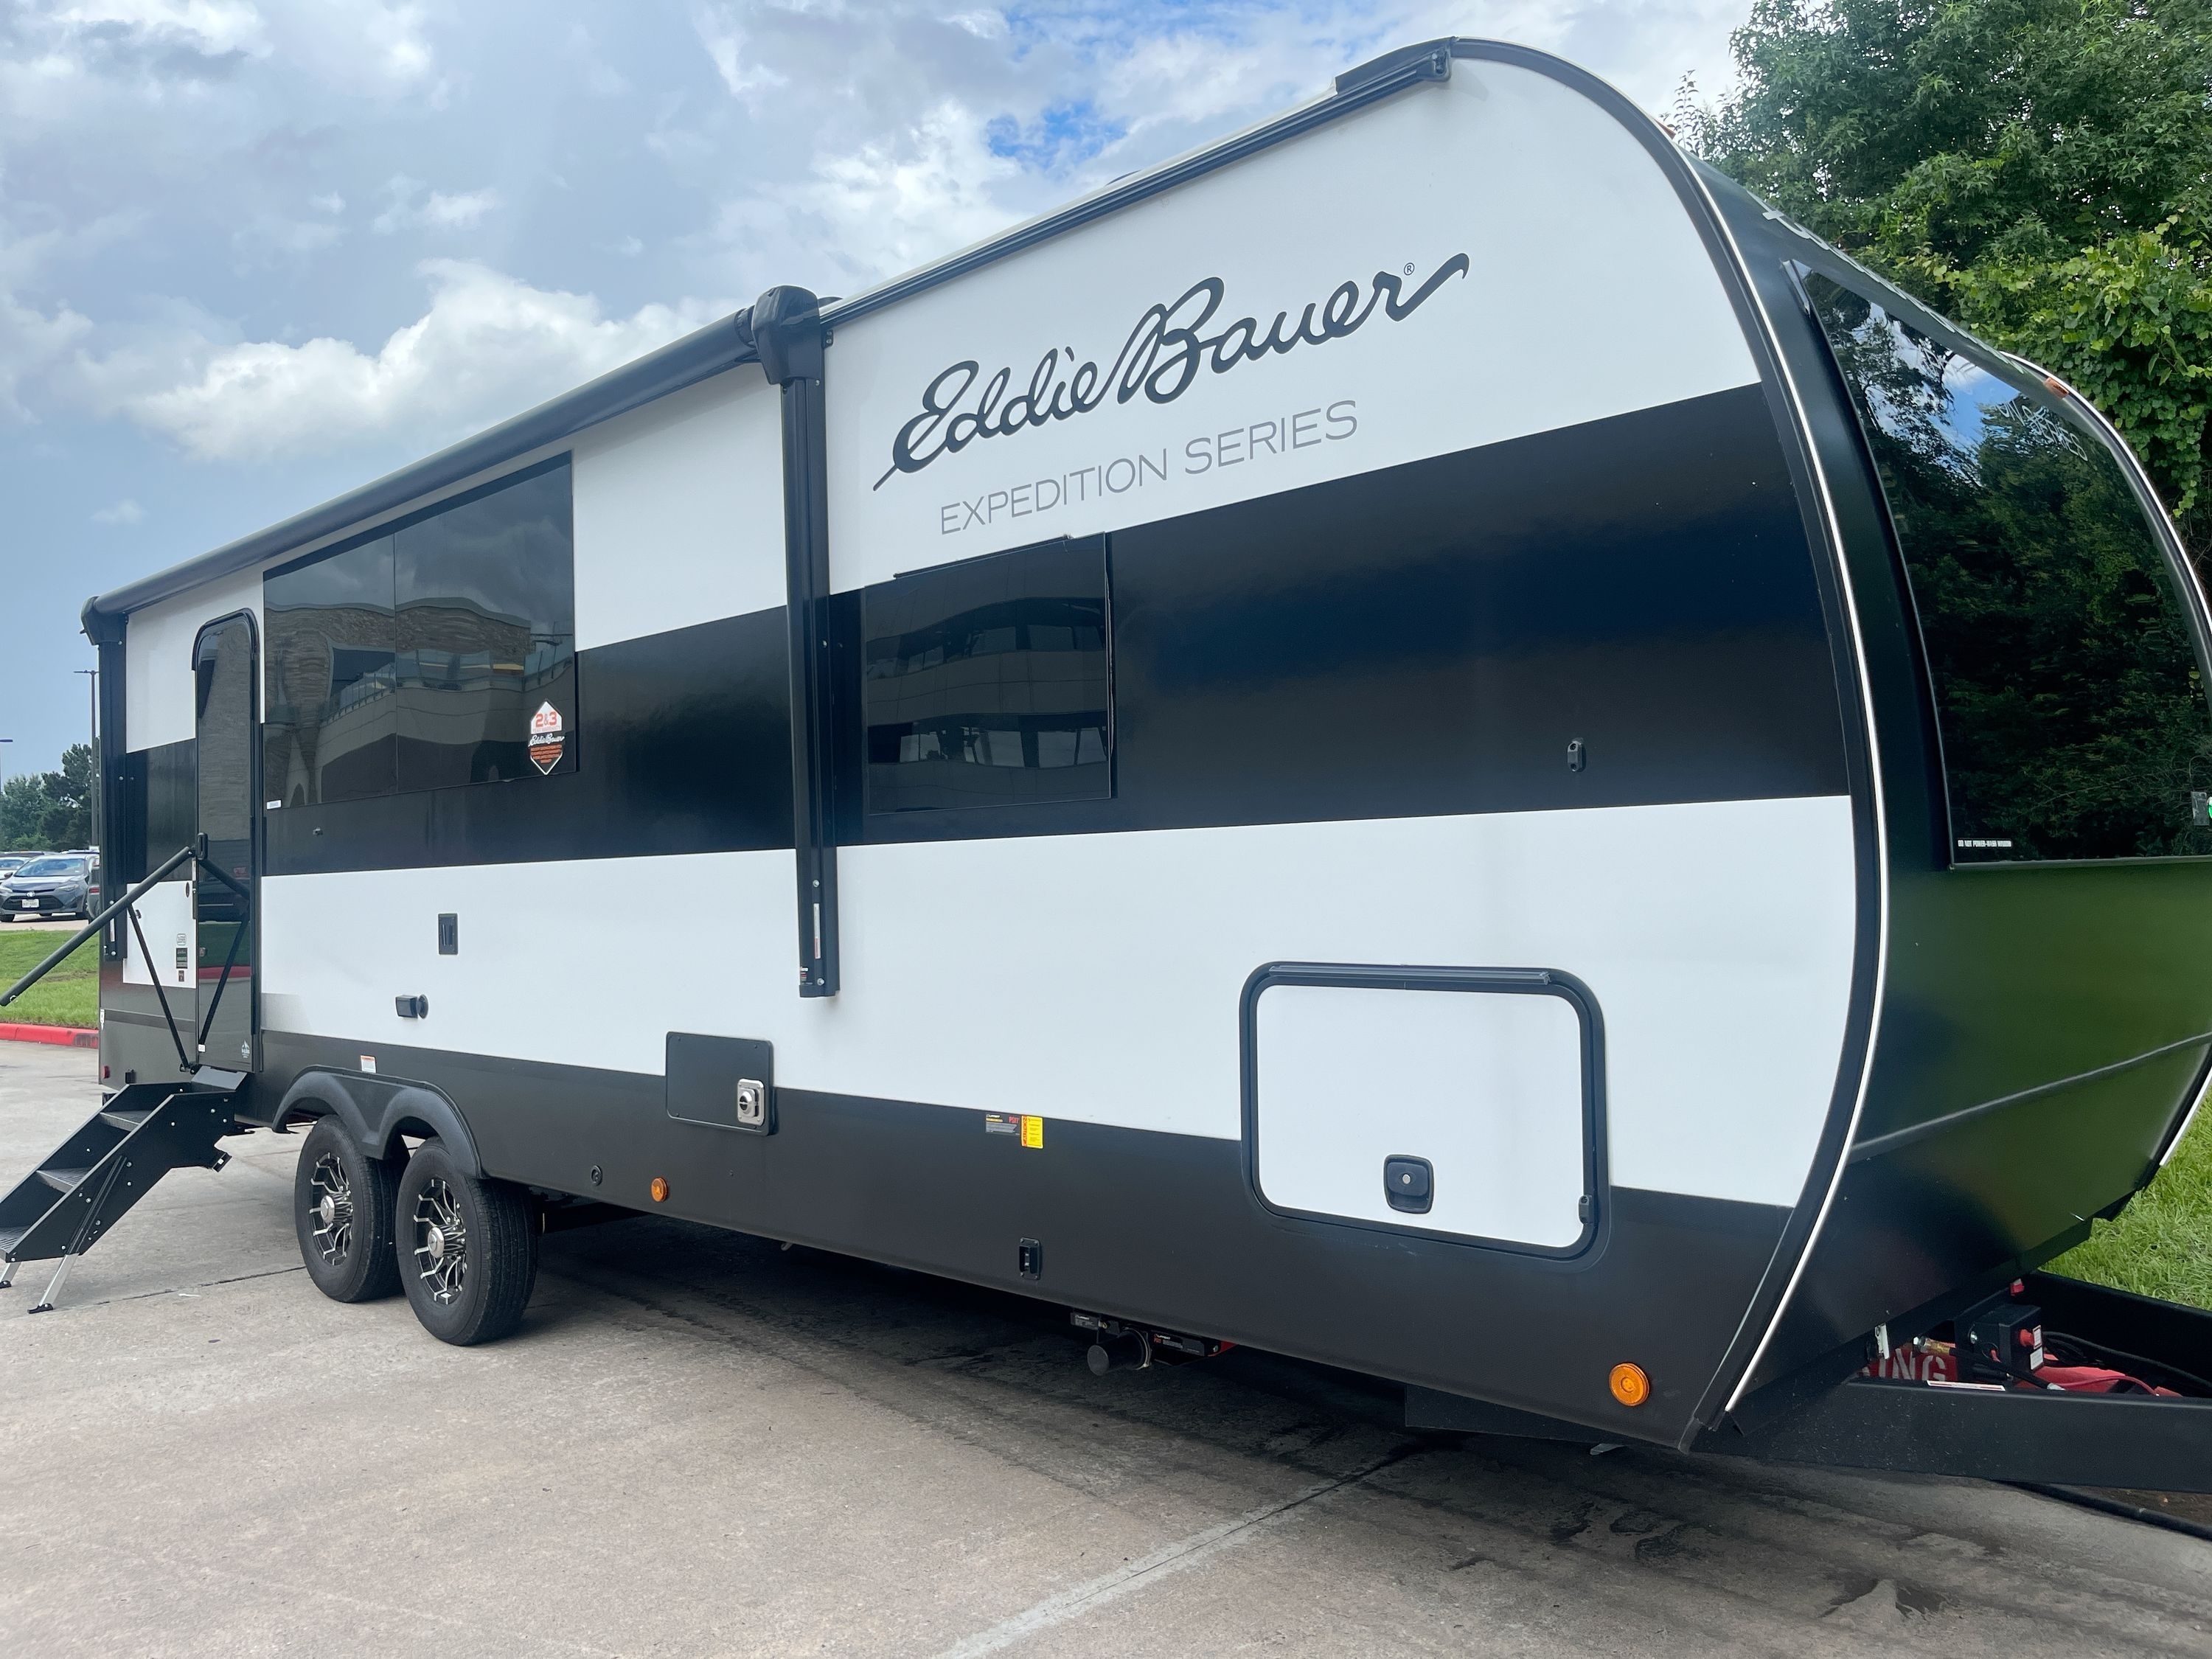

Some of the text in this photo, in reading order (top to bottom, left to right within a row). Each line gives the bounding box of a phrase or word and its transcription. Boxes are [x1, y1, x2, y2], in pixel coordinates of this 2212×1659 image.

[873, 253, 1470, 491] Eddie Bauer
[940, 400, 1359, 535] EXPEDITION SERIES
[536, 712, 557, 727] 2&3
[1862, 1348, 1947, 1381] ING
